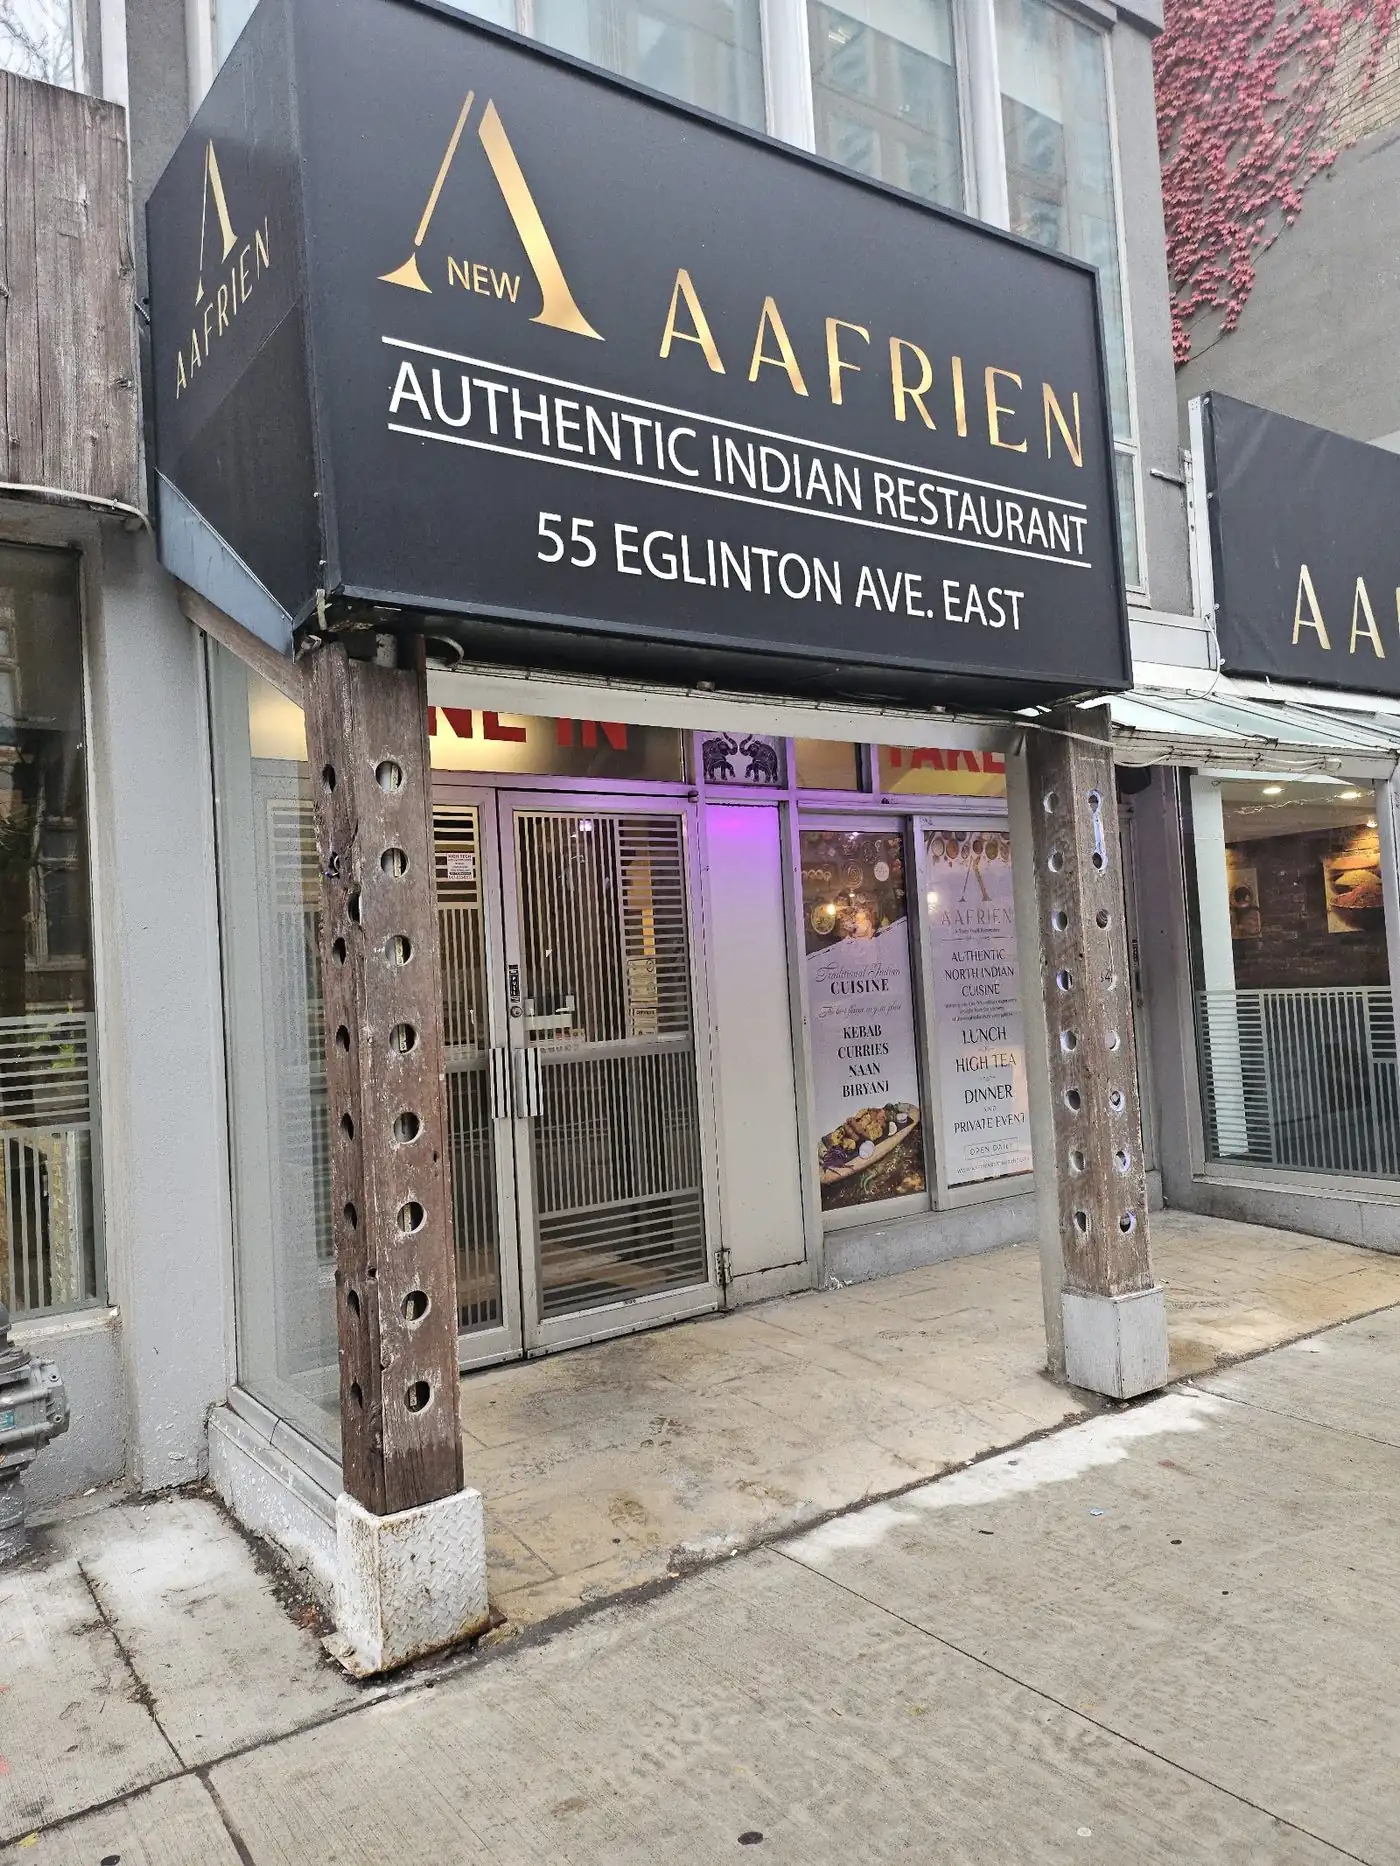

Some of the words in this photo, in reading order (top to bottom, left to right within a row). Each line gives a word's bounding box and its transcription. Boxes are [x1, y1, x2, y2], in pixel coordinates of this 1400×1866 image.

[447, 256, 520, 303] NEW
[176, 216, 270, 399] AAFRIEN
[659, 268, 1083, 468] AAFRIEN
[389, 361, 699, 477] AUTHENTIC
[712, 435, 861, 511] INDIAN
[875, 474, 1087, 555] RESTAURANT
[537, 512, 596, 567] 55
[615, 523, 842, 605] EGLINTON
[855, 567, 934, 620] AVE.
[944, 580, 1024, 631] EAST
[1292, 564, 1400, 659] AA
[942, 907, 1013, 926] AAFRIEN
[952, 949, 1006, 962] AUTHENTIC
[945, 967, 979, 980] NORTH
[981, 966, 1014, 978] INDIAN
[831, 979, 889, 995] CUISINE
[962, 984, 1000, 997] CUISINE
[843, 1024, 882, 1039] KEBAB
[962, 1026, 1007, 1044] LUNCH
[838, 1043, 889, 1059] CURRIES
[848, 1062, 881, 1077] NAAN
[956, 1055, 988, 1072] HIGH
[993, 1053, 1016, 1067] TEA
[842, 1080, 889, 1097] BIRYANI
[965, 1084, 1013, 1104] DINNER
[954, 1117, 993, 1134] PRIVATE
[996, 1113, 1025, 1128] EVENT
[970, 1146, 990, 1155] OPEN
